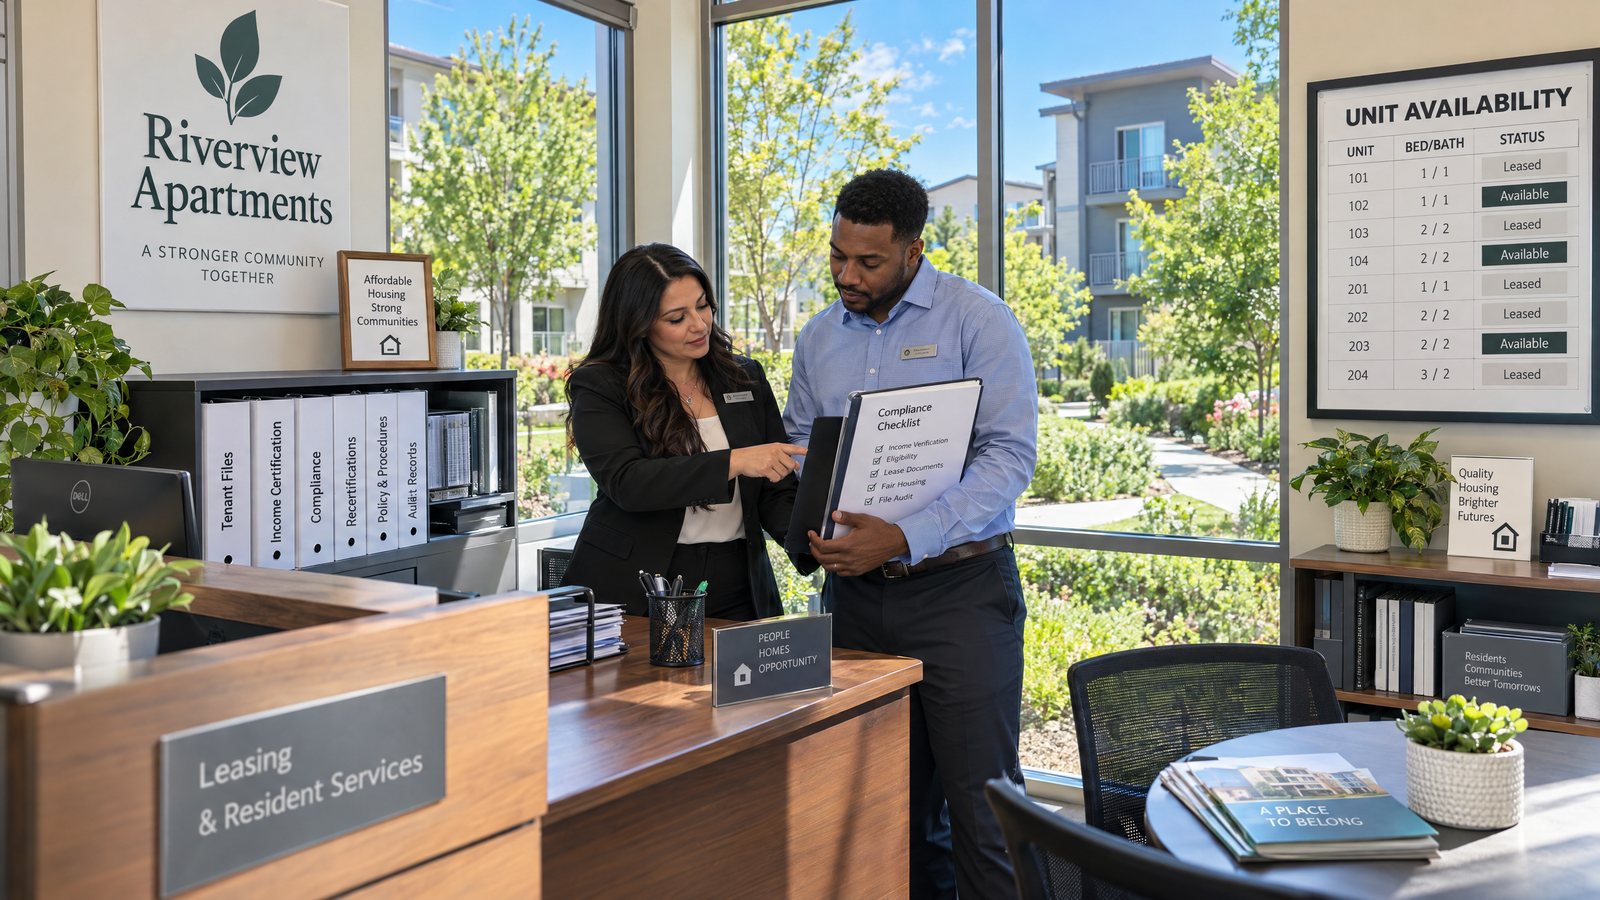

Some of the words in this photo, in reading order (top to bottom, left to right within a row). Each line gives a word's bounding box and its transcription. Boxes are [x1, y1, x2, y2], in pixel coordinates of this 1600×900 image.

[1346, 104, 1398, 126] UNIT
[1405, 87, 1572, 121] AVAILABILITY
[143, 112, 322, 179] Riverview
[1348, 145, 1374, 157] UNIT
[1406, 138, 1464, 152] BED/BATH
[1501, 131, 1544, 145] STATUS
[1350, 173, 1368, 183] 101
[1421, 168, 1427, 178] 1
[1443, 167, 1449, 177] 1
[1504, 159, 1541, 172] Leased
[131, 164, 332, 225] Apartments
[1350, 200, 1368, 211] 102
[1421, 196, 1427, 206] 1
[1443, 195, 1449, 205] 1
[1500, 188, 1549, 201] Available
[1349, 228, 1368, 239] 103
[1421, 224, 1427, 235] 2
[1443, 223, 1449, 234] 2
[1504, 218, 1541, 230] Leased
[142, 245, 151, 257] A
[159, 246, 238, 262] STRONGER
[245, 252, 324, 267] COMMUNITY
[1349, 256, 1368, 266] 104
[1421, 253, 1427, 263] 2
[1443, 252, 1449, 262] 2
[1501, 248, 1549, 260] Available
[201, 269, 273, 284] TOGETHER
[364, 275, 412, 285] Affordable
[1348, 284, 1368, 294] 201
[1421, 282, 1428, 292] 1
[1443, 281, 1450, 291] 1
[1504, 278, 1541, 289] Leased
[368, 289, 405, 301] Housing
[372, 303, 402, 314] Strong
[1348, 312, 1367, 323] 202
[1421, 311, 1427, 321] 2
[1443, 310, 1449, 320] 2
[1504, 307, 1540, 319] Leased
[357, 316, 418, 326] Communities
[1349, 341, 1369, 351] 203
[1421, 339, 1427, 350] 2
[1443, 338, 1449, 349] 2
[1501, 337, 1548, 348] Available
[1348, 370, 1368, 380] 204
[1421, 369, 1427, 380] 3
[1443, 368, 1450, 379] 2
[1504, 369, 1540, 379] Leased
[878, 405, 932, 417] Compliance
[878, 419, 920, 431] Checklist
[377, 416, 387, 476] Procedures
[914, 439, 948, 447] Verification
[270, 422, 281, 495] Certification
[887, 454, 917, 463] Eligibility
[221, 452, 233, 481] Files
[906, 463, 943, 473] Documents
[346, 437, 356, 526] Recertifications
[1459, 468, 1493, 481] Quality
[310, 452, 323, 523] Compliance
[377, 480, 387, 488] &
[1459, 483, 1498, 495] Housing
[73, 492, 88, 501] DELL
[1459, 497, 1498, 509] Brighter
[222, 486, 232, 531] Tenant
[378, 491, 390, 522] Policy
[271, 500, 281, 542] Income
[1458, 511, 1494, 522] Futures
[759, 630, 790, 642] PEOPLE
[759, 645, 790, 657] HOMES
[1465, 652, 1507, 664] Residents
[758, 655, 818, 674] OPPORTUNITY
[1465, 664, 1523, 679] Communities
[1464, 676, 1490, 687] Better
[1493, 679, 1540, 692] Tomorrows
[199, 746, 293, 789] Leasing
[199, 808, 218, 837] &
[224, 780, 324, 829] Resident
[331, 754, 423, 798] Services
[1260, 806, 1272, 815] A
[1275, 806, 1329, 815] PLACE
[1266, 818, 1291, 827] TO
[1295, 818, 1363, 826] BELONG
